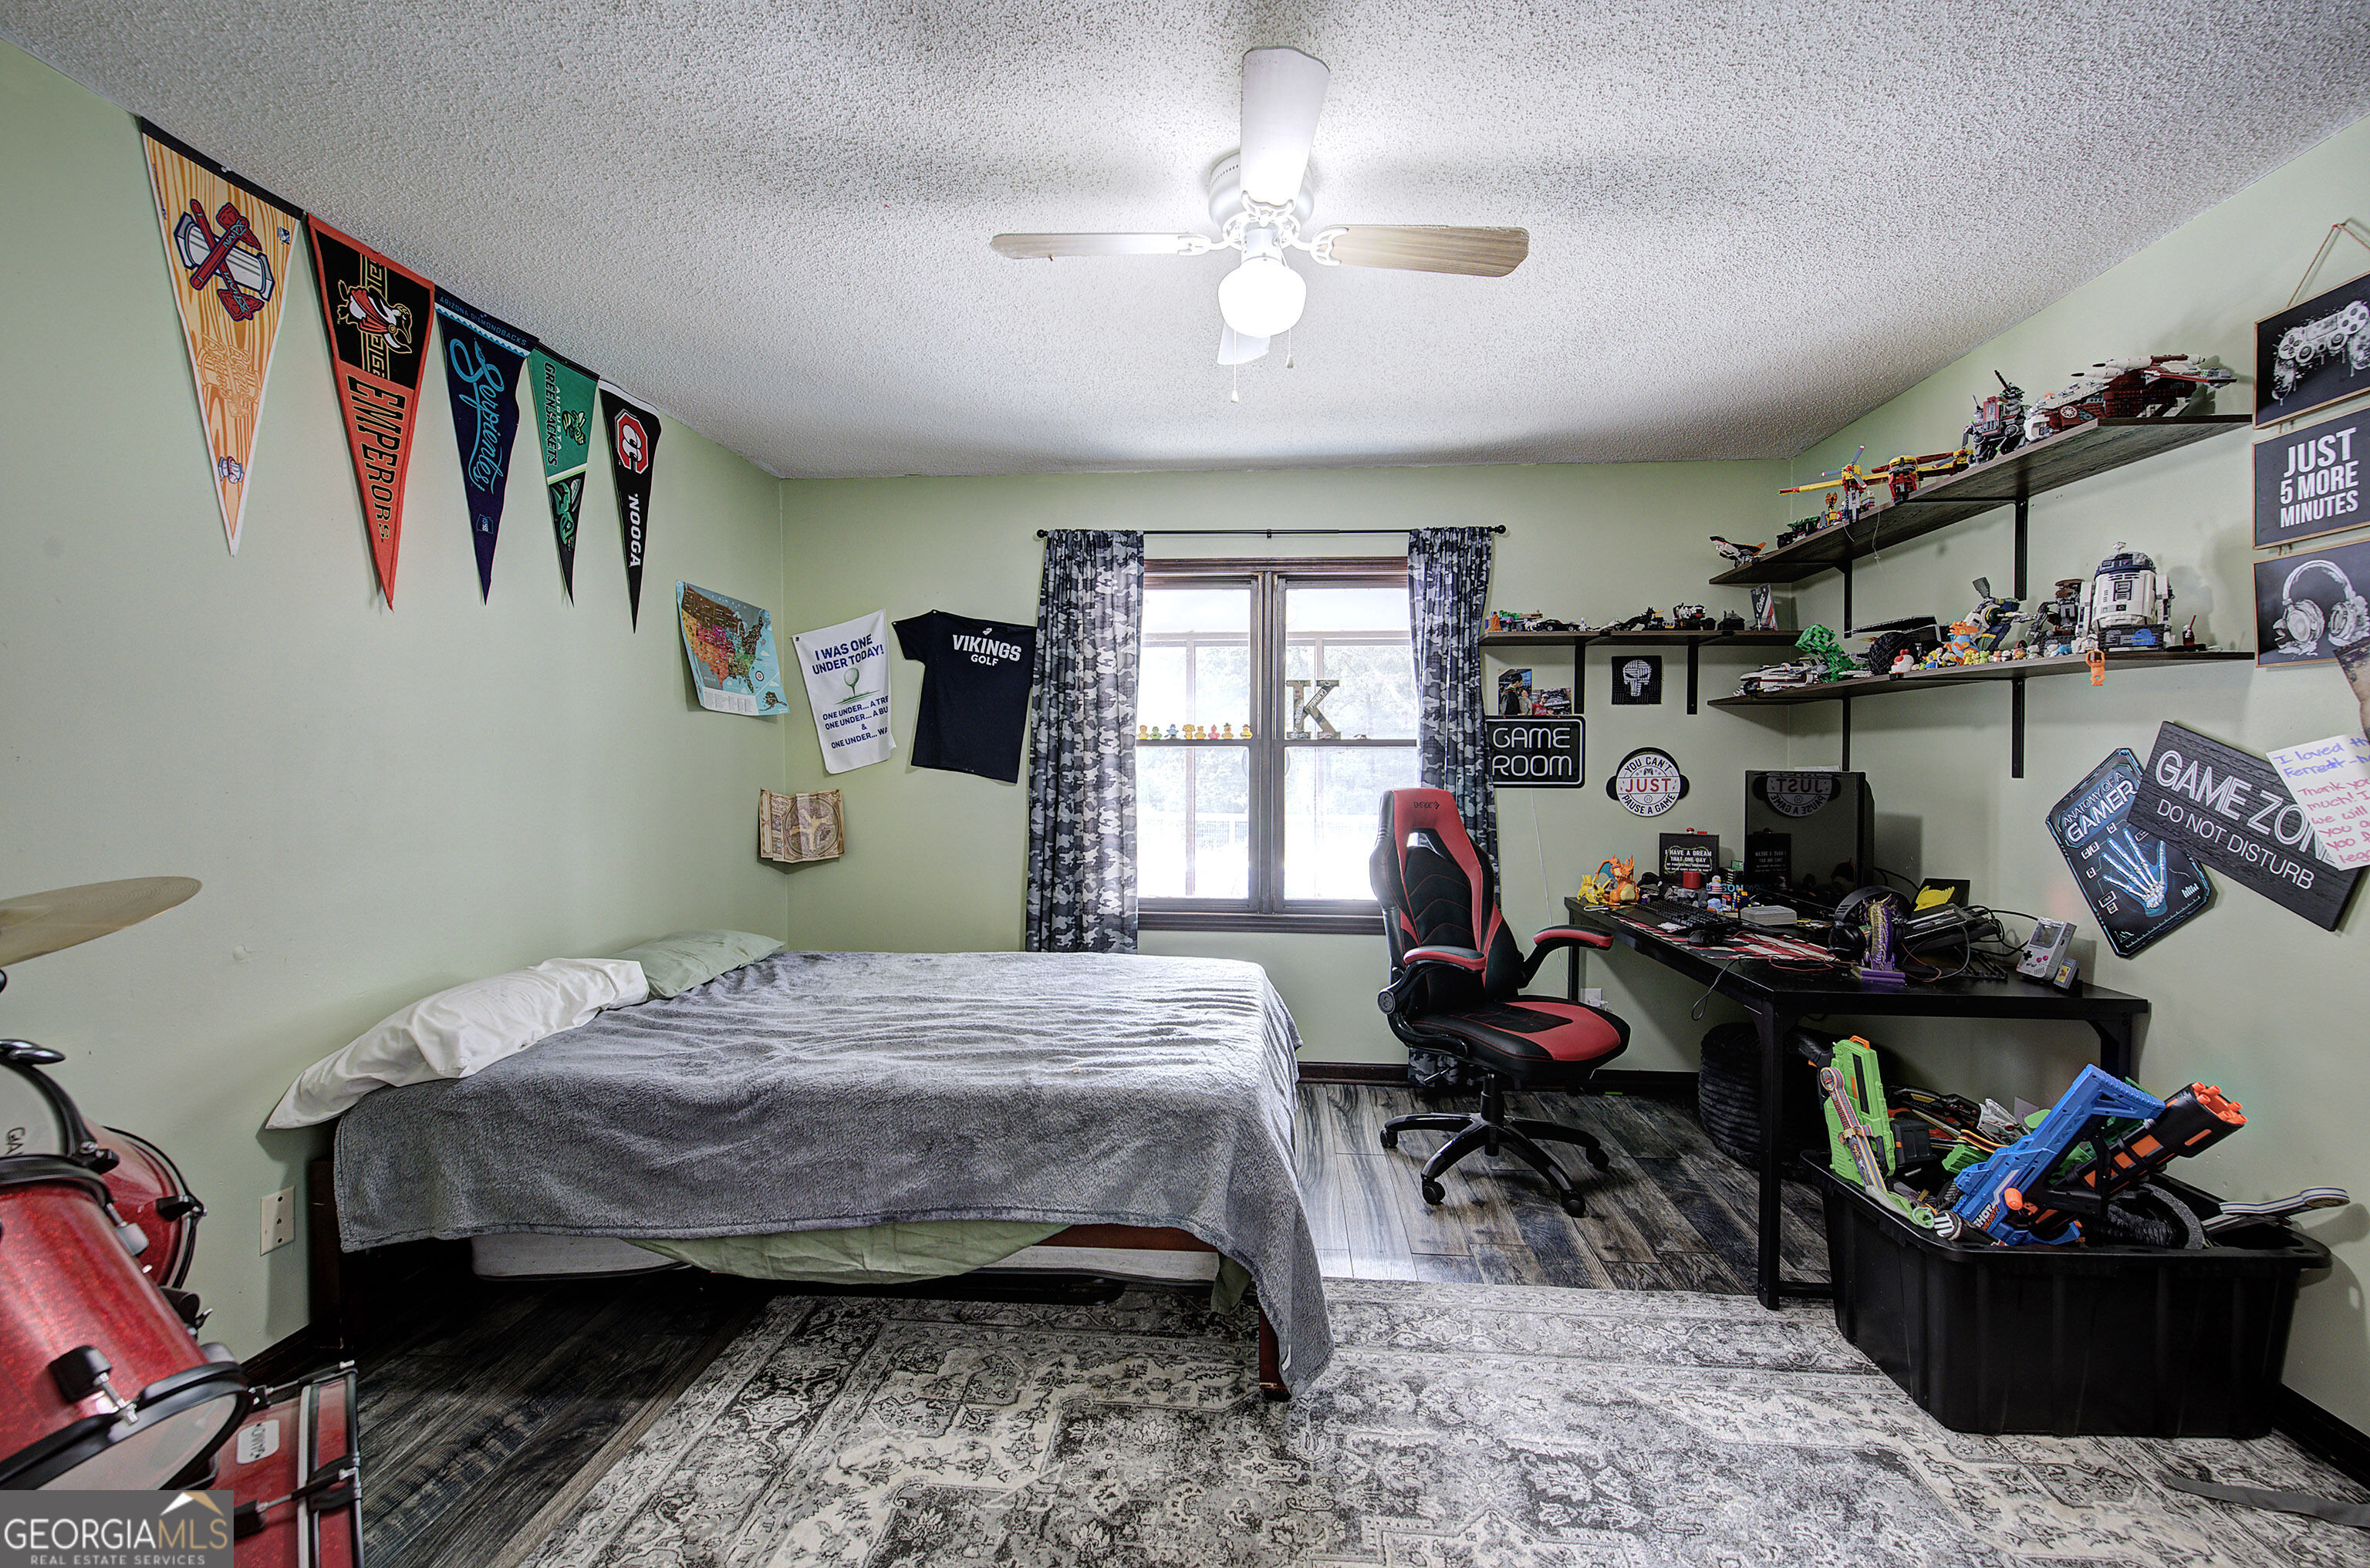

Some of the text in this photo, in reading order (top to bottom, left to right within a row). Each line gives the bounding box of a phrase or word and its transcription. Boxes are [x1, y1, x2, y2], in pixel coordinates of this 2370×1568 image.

[440, 296, 527, 346] ARIZONA DIAMONDBACKS
[450, 338, 505, 494] Serpientes
[544, 362, 558, 467] GREENJACKETS
[346, 373, 407, 540] EMPERORS
[2284, 427, 2357, 478] JUST
[2280, 460, 2359, 504] 5 MORE
[2281, 490, 2359, 528] MINUTES
[812, 644, 884, 675] UNDER TODAY!
[815, 634, 873, 661] I WAS ONE
[952, 634, 1021, 662] VIKINGS
[971, 654, 999, 666] GOLF
[822, 711, 838, 720] ONE
[839, 703, 869, 717] UNDER...
[825, 721, 839, 730] ONE
[840, 713, 872, 727] UNDER...
[831, 740, 845, 749] ONE
[846, 732, 877, 745] UNDER...
[1492, 727, 1571, 748] GAME
[1492, 755, 1572, 776] ROOM
[1625, 757, 1673, 773] YOU CAN'T
[2273, 754, 2293, 764] I
[2294, 743, 2345, 761] loved
[1625, 778, 1671, 792] JUST
[2297, 781, 2347, 796] Thank
[1622, 795, 1645, 814] PAUSE
[1654, 794, 1676, 812] GAME
[2064, 771, 2125, 827] ANATOMY OF A
[2068, 780, 2138, 842] GAMER
[2156, 750, 2336, 865] GAME ZON
[2307, 792, 2358, 811] much!
[2311, 805, 2368, 824] we will
[2318, 825, 2351, 838] you
[2157, 799, 2314, 890] DO NOT DISTURB
